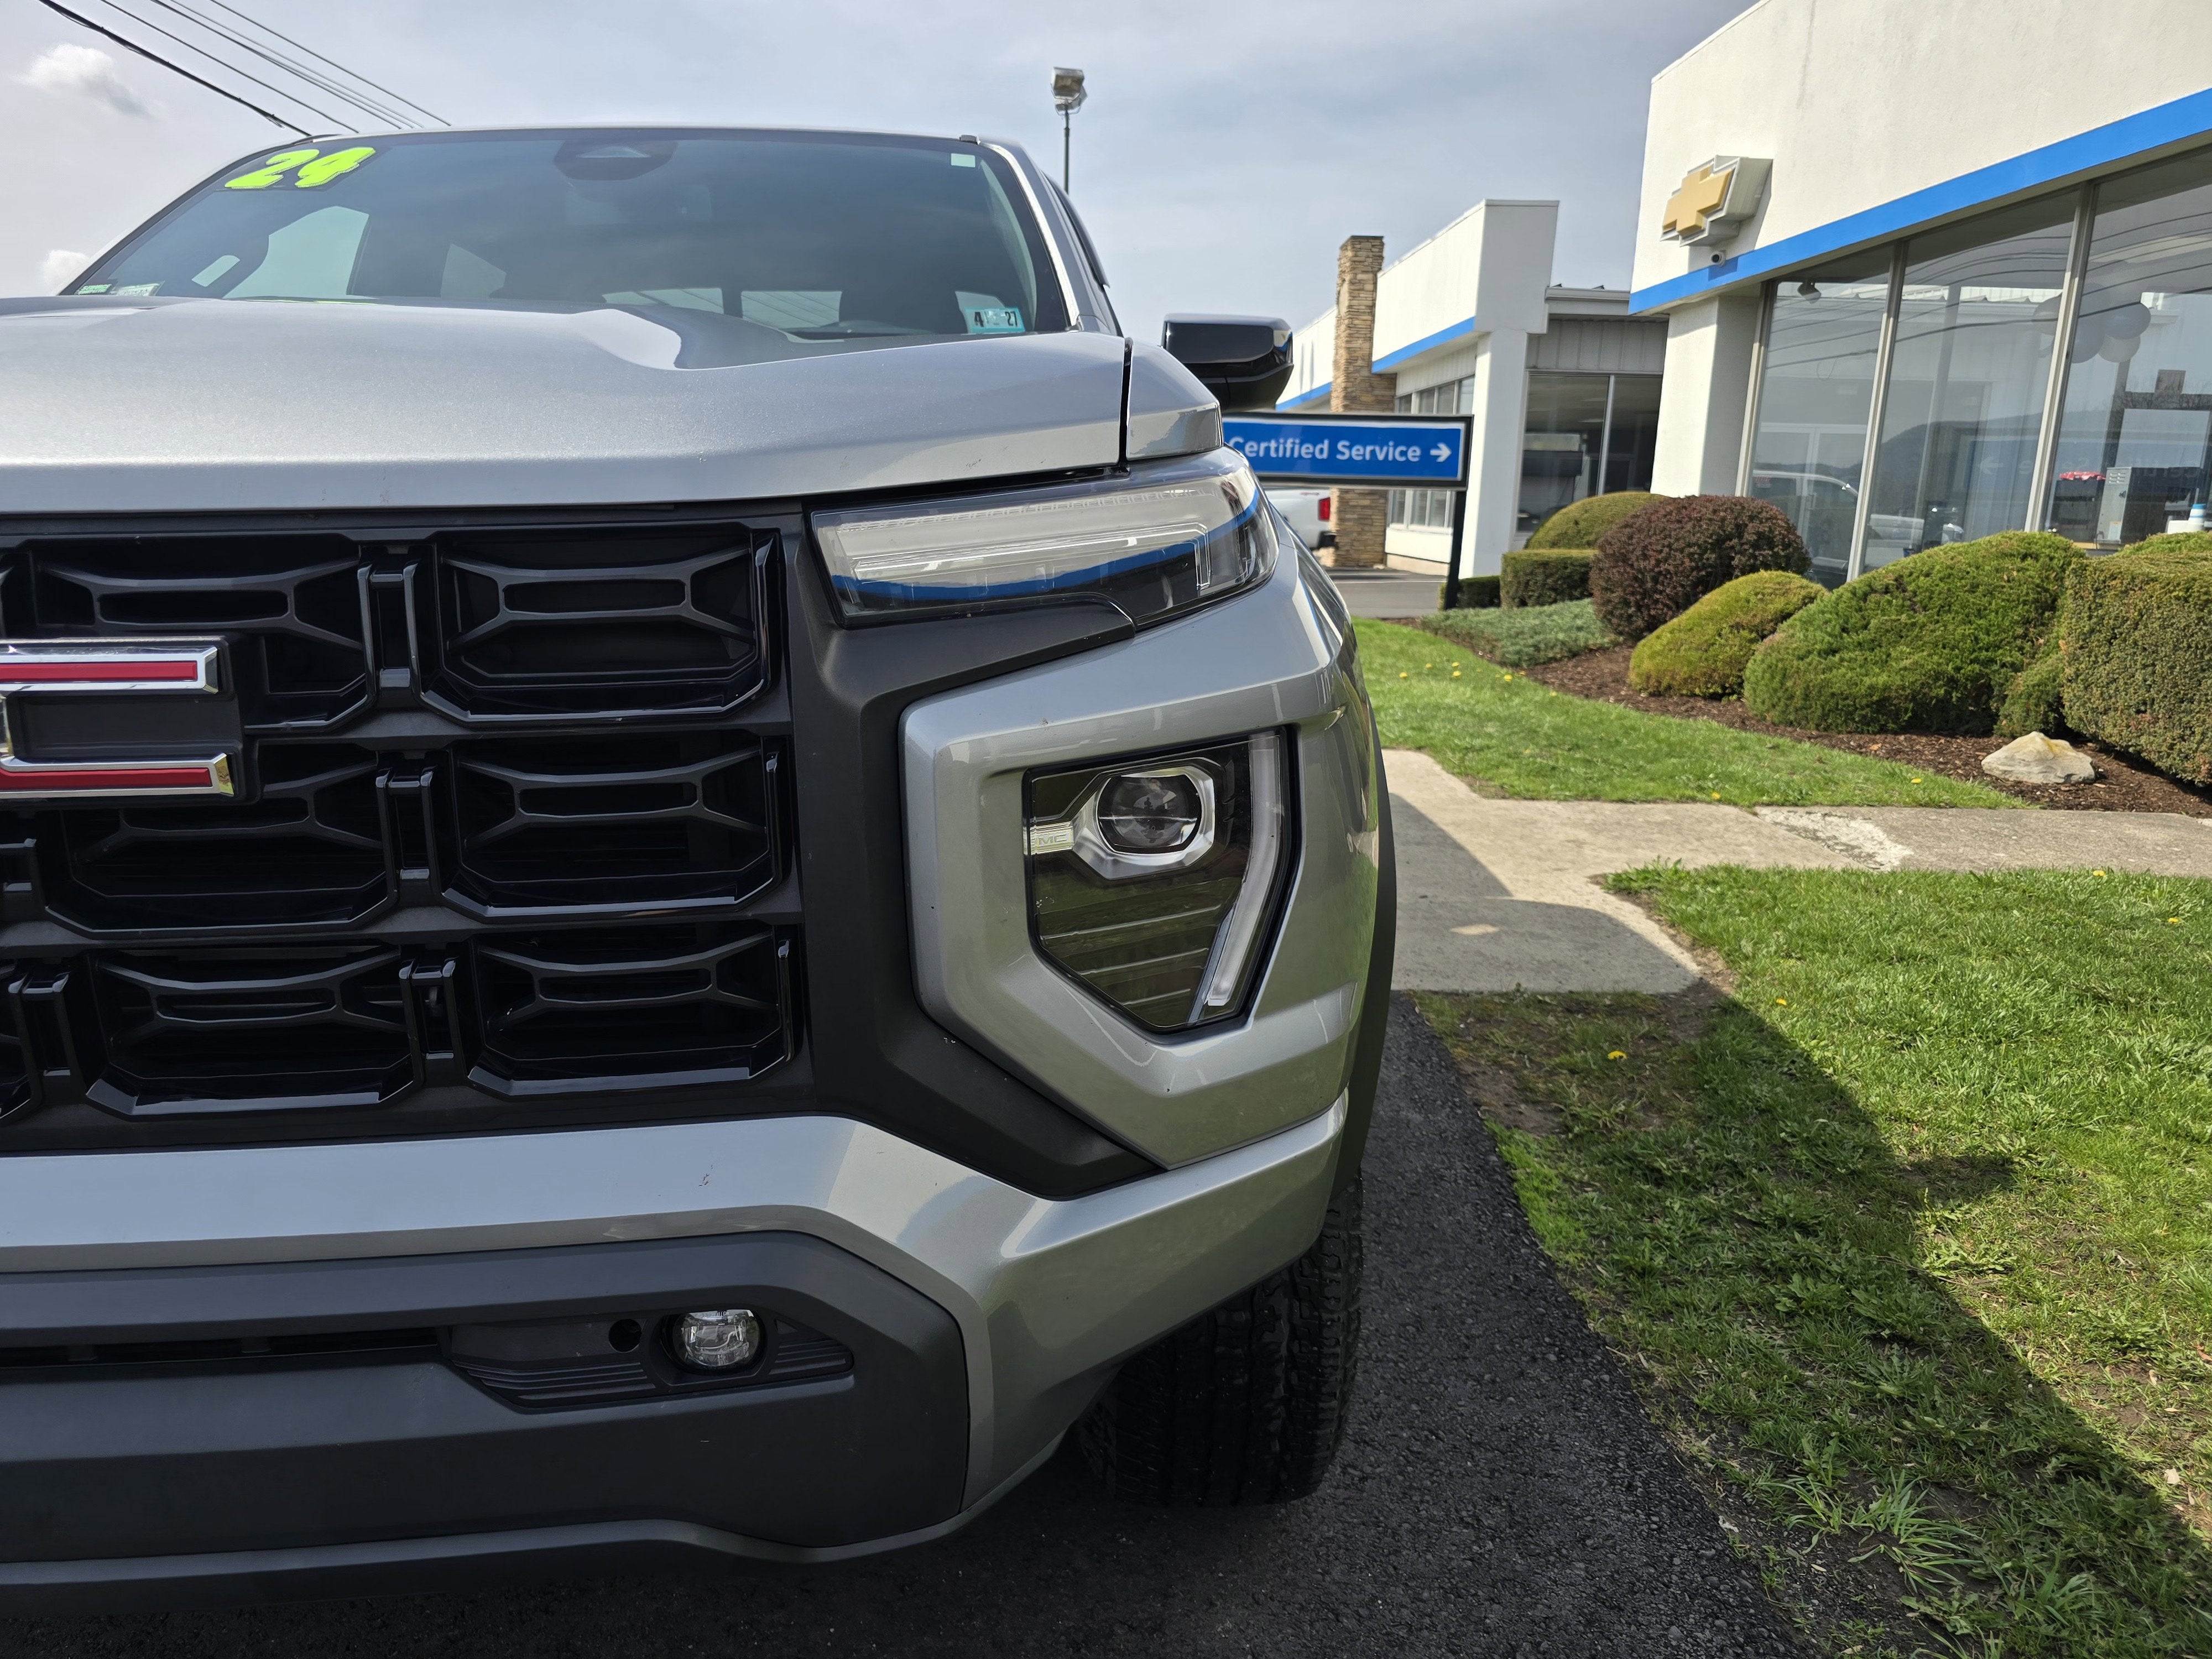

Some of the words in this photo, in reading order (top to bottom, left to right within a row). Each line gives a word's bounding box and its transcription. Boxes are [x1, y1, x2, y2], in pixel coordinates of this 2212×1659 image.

[224, 147, 376, 189] 24
[974, 311, 984, 327] 4
[1005, 311, 1018, 326] 27
[1336, 440, 1421, 461] Service
